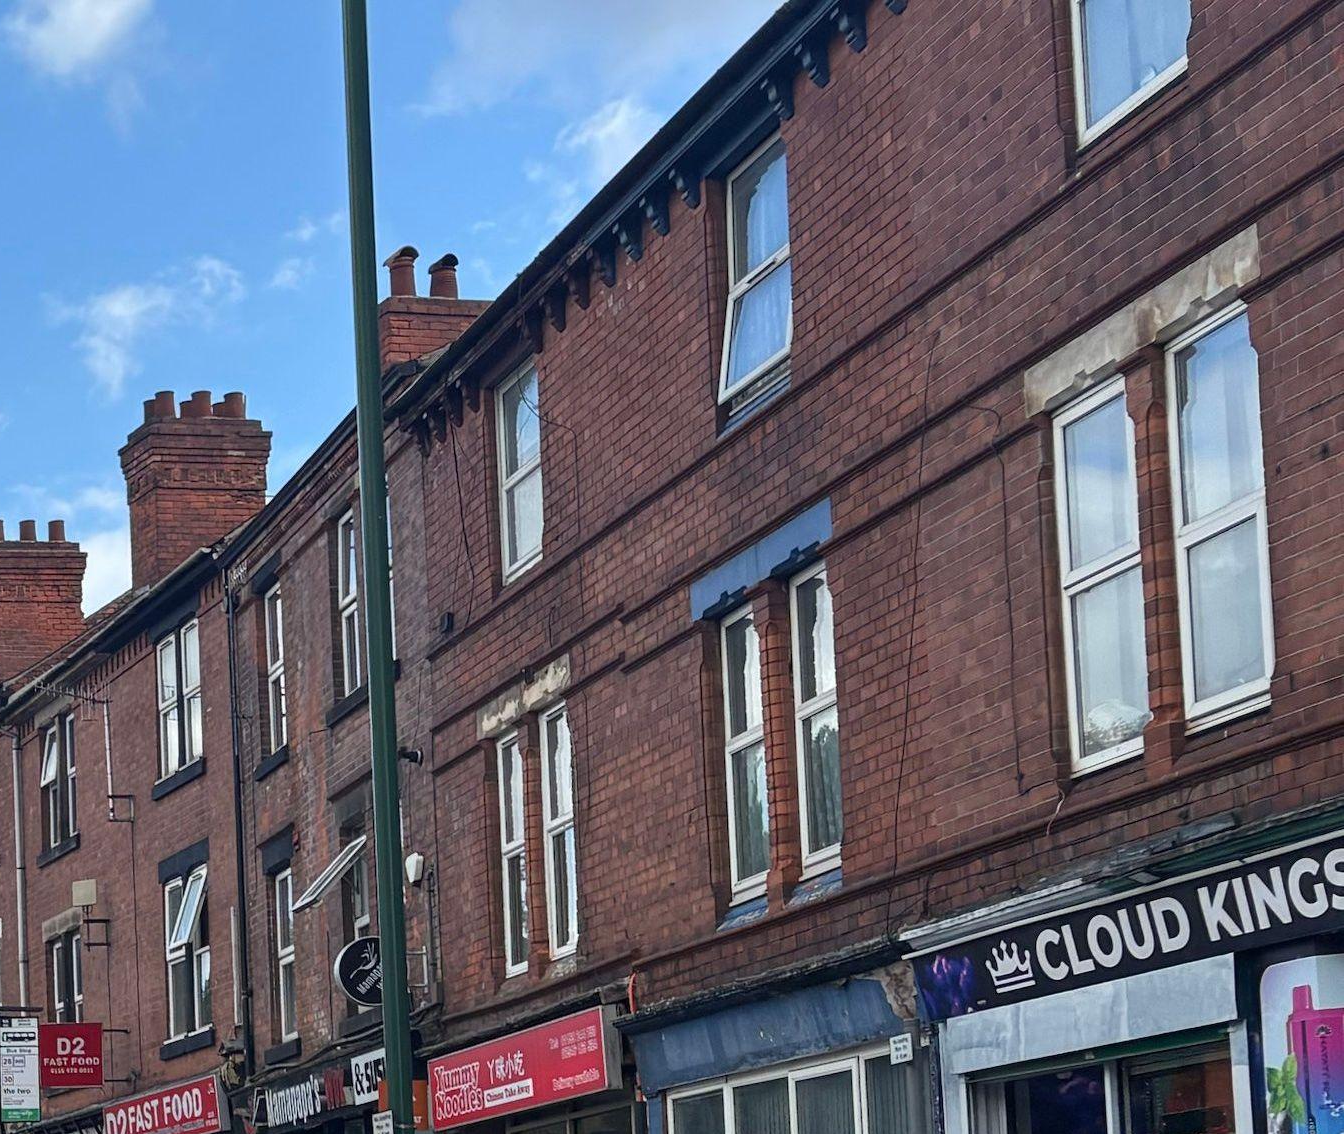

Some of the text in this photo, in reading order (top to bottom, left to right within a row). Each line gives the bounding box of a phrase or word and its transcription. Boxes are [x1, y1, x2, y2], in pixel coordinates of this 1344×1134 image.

[1035, 848, 1344, 980] CLOUD KINGS
[43, 1057, 100, 1066] FAST FOOD
[57, 1036, 85, 1055] D2
[434, 1061, 480, 1093] Yummy
[128, 1099, 159, 1134] FAST
[163, 1087, 203, 1125] FOOD
[265, 1073, 322, 1128] Mamapapa's
[435, 1083, 484, 1120] Noodles
